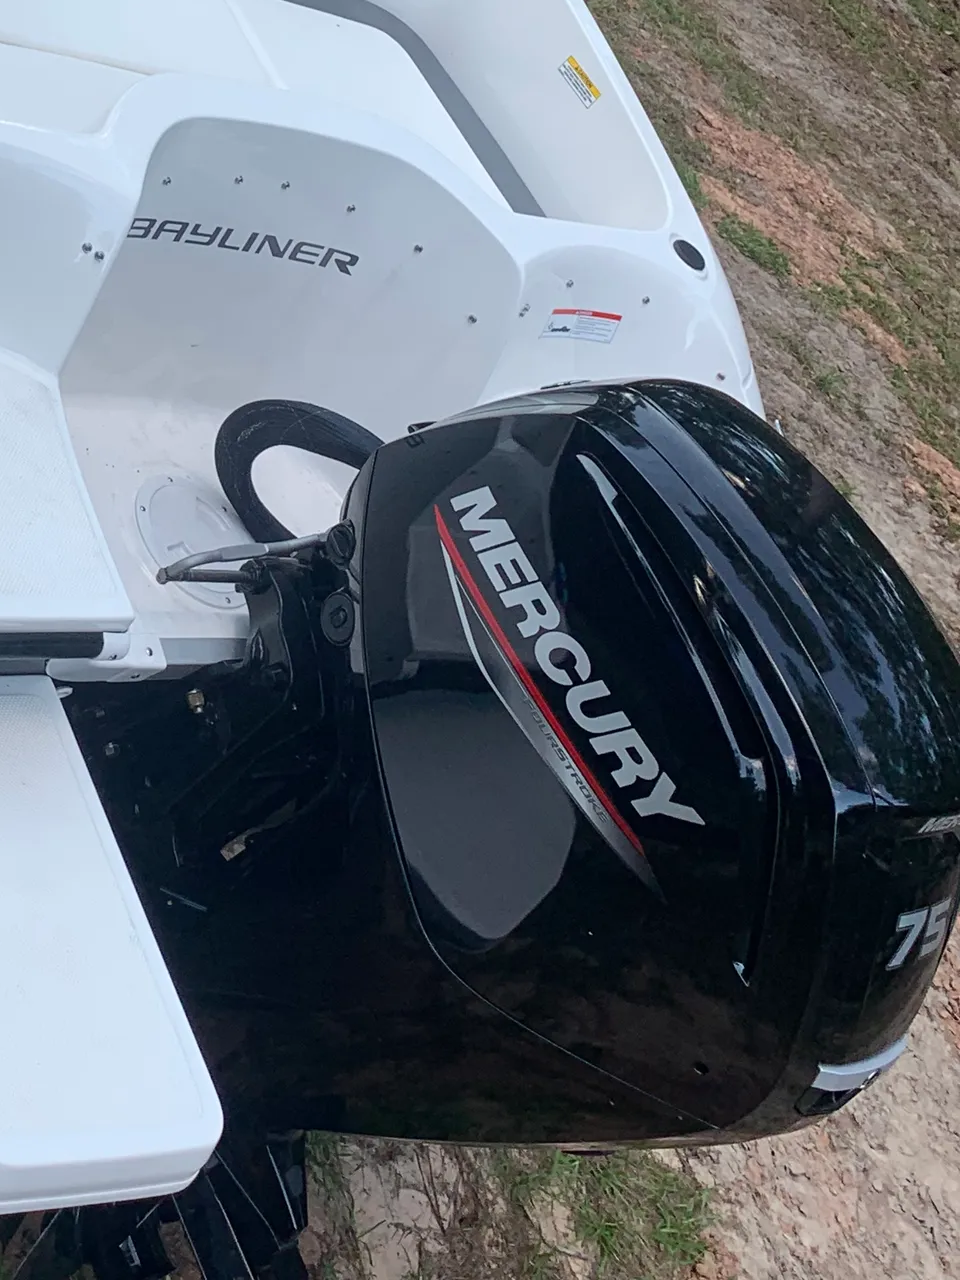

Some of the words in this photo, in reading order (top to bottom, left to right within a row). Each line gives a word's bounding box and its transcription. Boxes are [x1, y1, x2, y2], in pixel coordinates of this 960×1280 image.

[126, 218, 359, 276] BAYLINER
[451, 485, 706, 825] MERCURY
[523, 696, 608, 823] FOURSTROKE
[885, 897, 951, 971] 75
